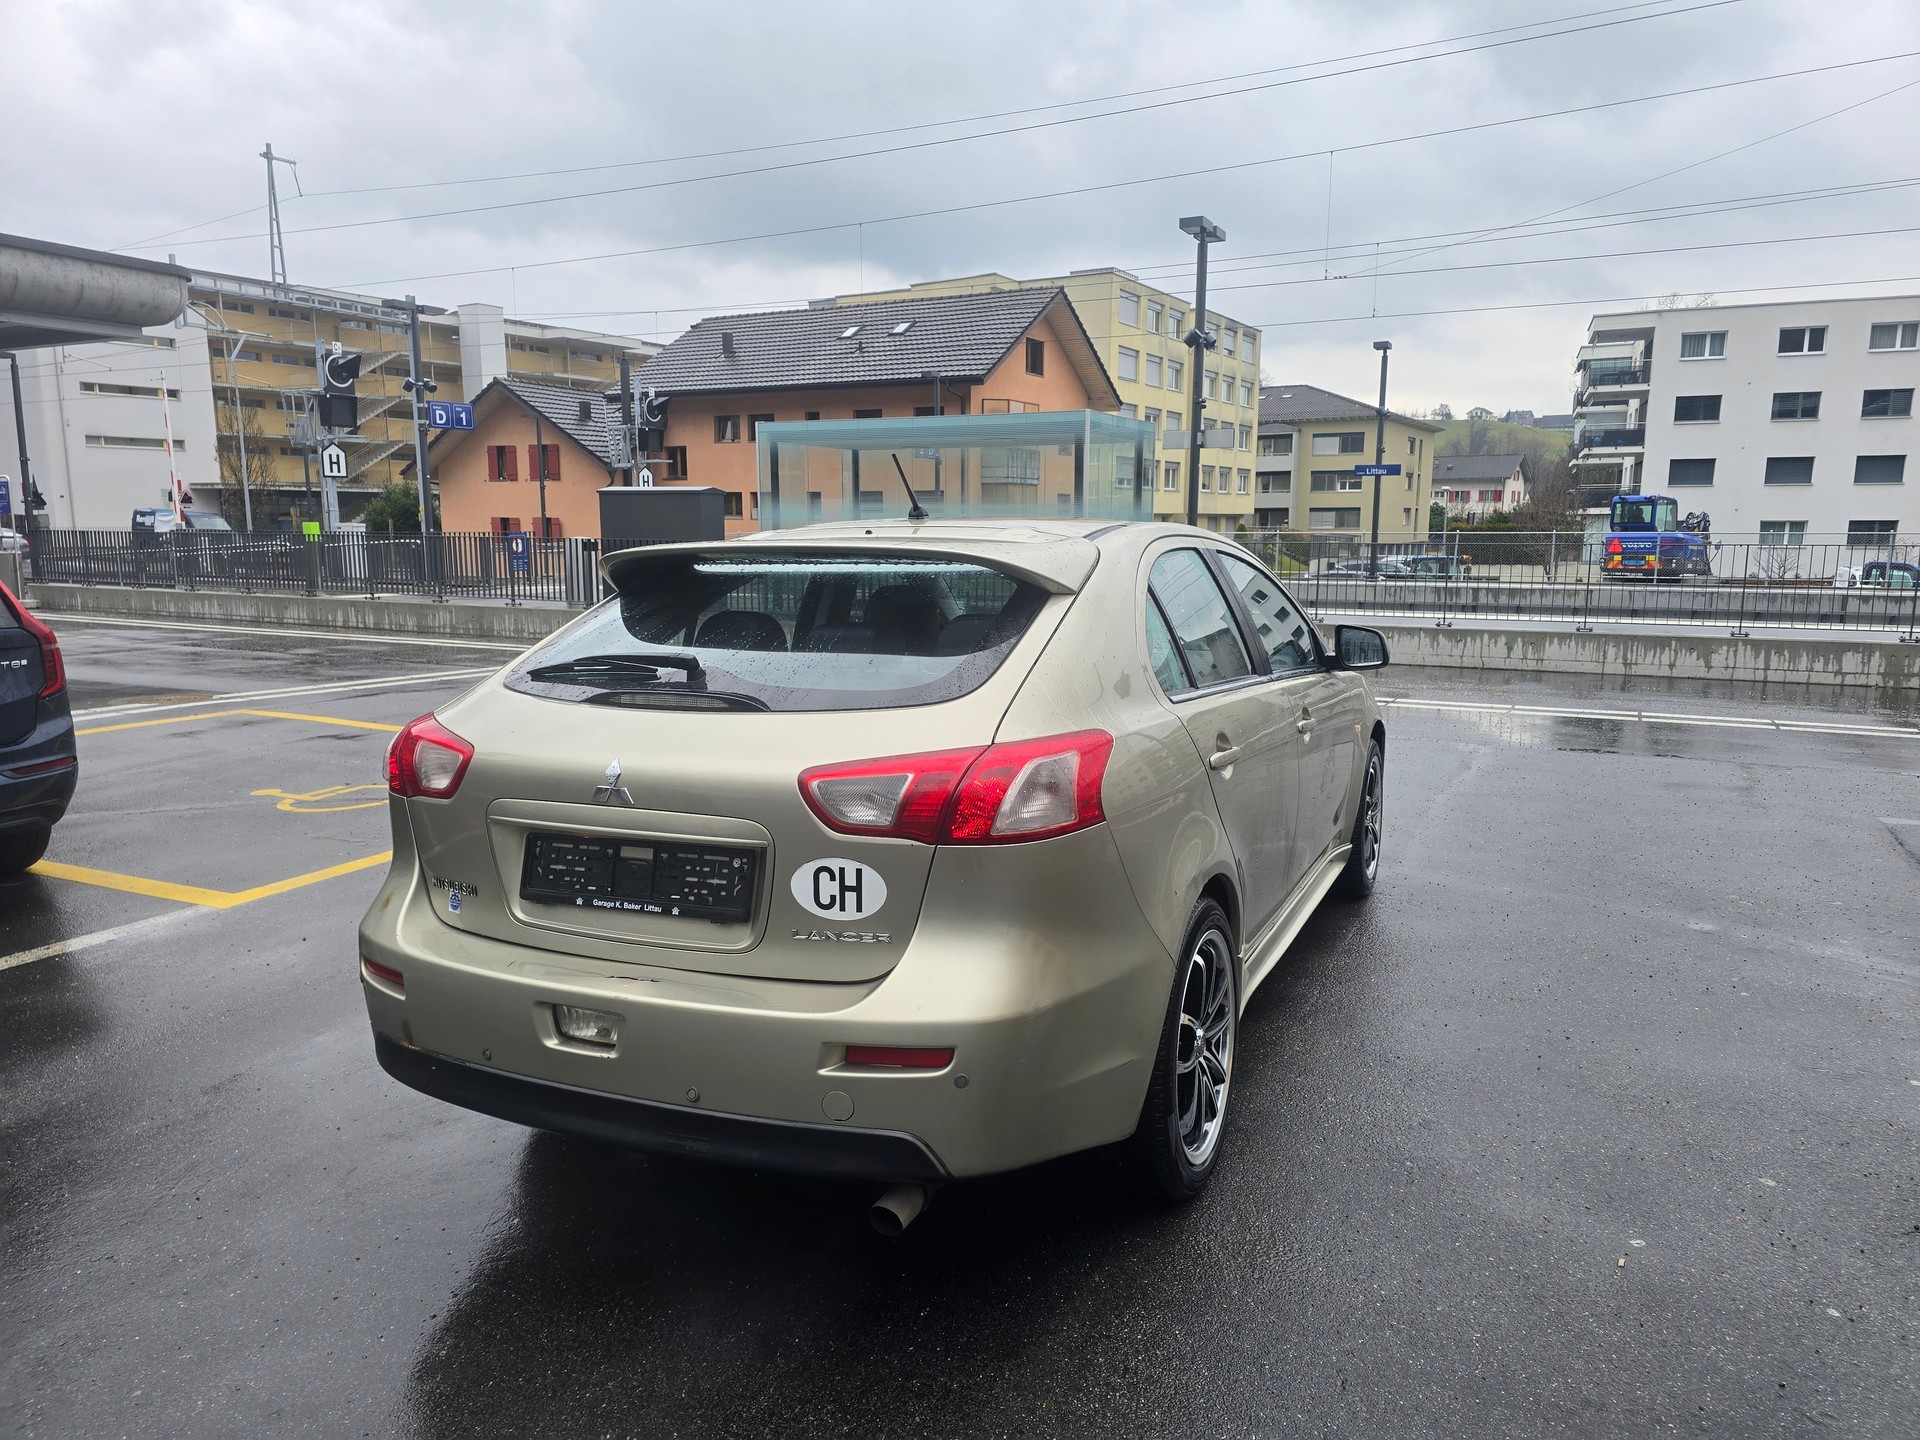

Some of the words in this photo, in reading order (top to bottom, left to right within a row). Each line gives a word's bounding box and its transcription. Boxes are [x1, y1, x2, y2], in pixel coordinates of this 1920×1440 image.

[436, 410, 446, 424] D
[460, 411, 466, 426] 1
[328, 453, 341, 473] H
[1366, 467, 1387, 475] Littau
[642, 475, 650, 487] H
[813, 865, 863, 913] CH
[592, 898, 615, 909] Garage
[615, 901, 623, 909] K.
[623, 902, 641, 910] Baker
[644, 904, 662, 912] Littau
[791, 928, 893, 944] LANCER
